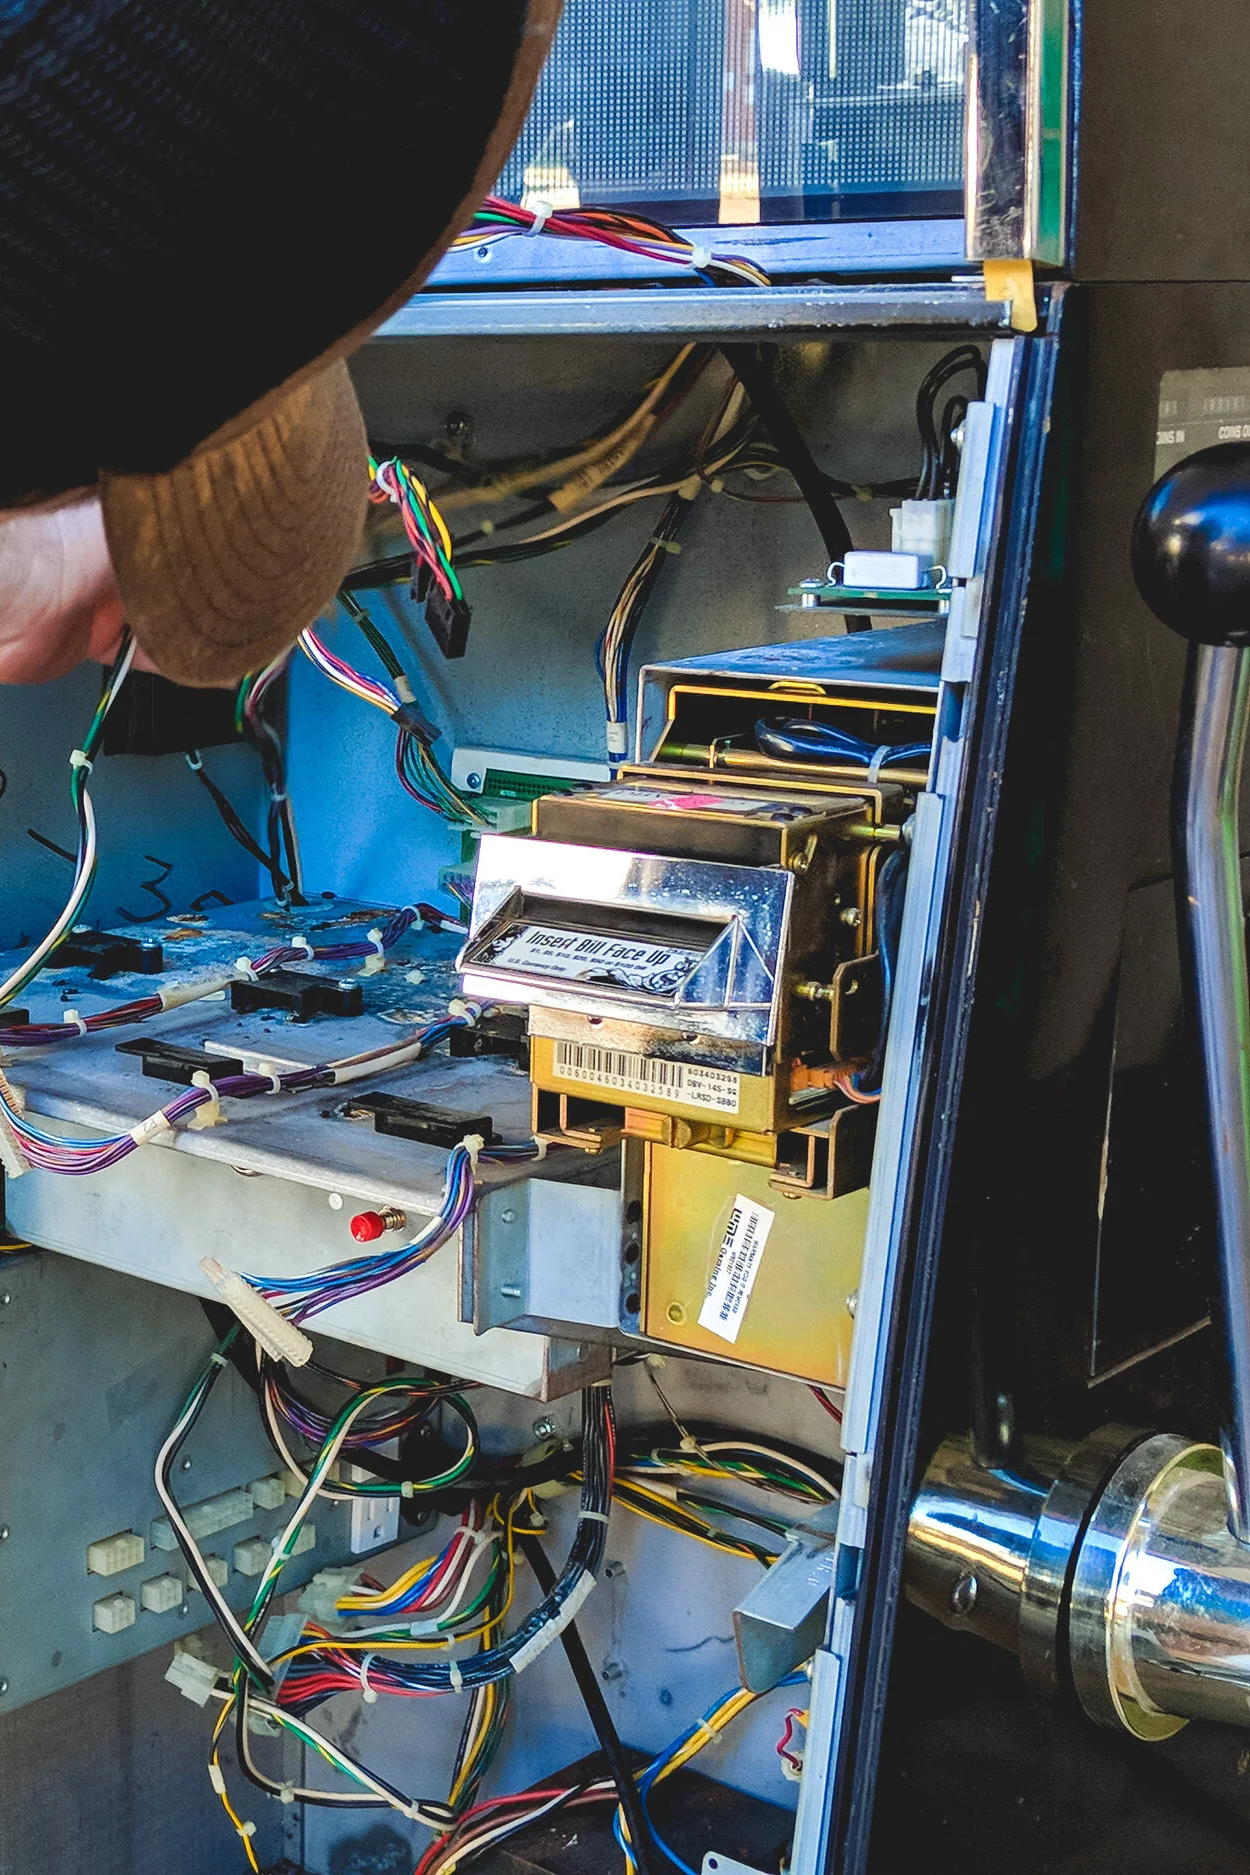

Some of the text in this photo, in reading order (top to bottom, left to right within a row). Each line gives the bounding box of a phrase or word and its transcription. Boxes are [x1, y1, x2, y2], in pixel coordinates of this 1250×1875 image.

[526, 931, 578, 949] Insert
[575, 939, 607, 954] Bill
[602, 944, 646, 961] Face
[646, 950, 671, 967] Up
[712, 1247, 727, 1281] Gaming
